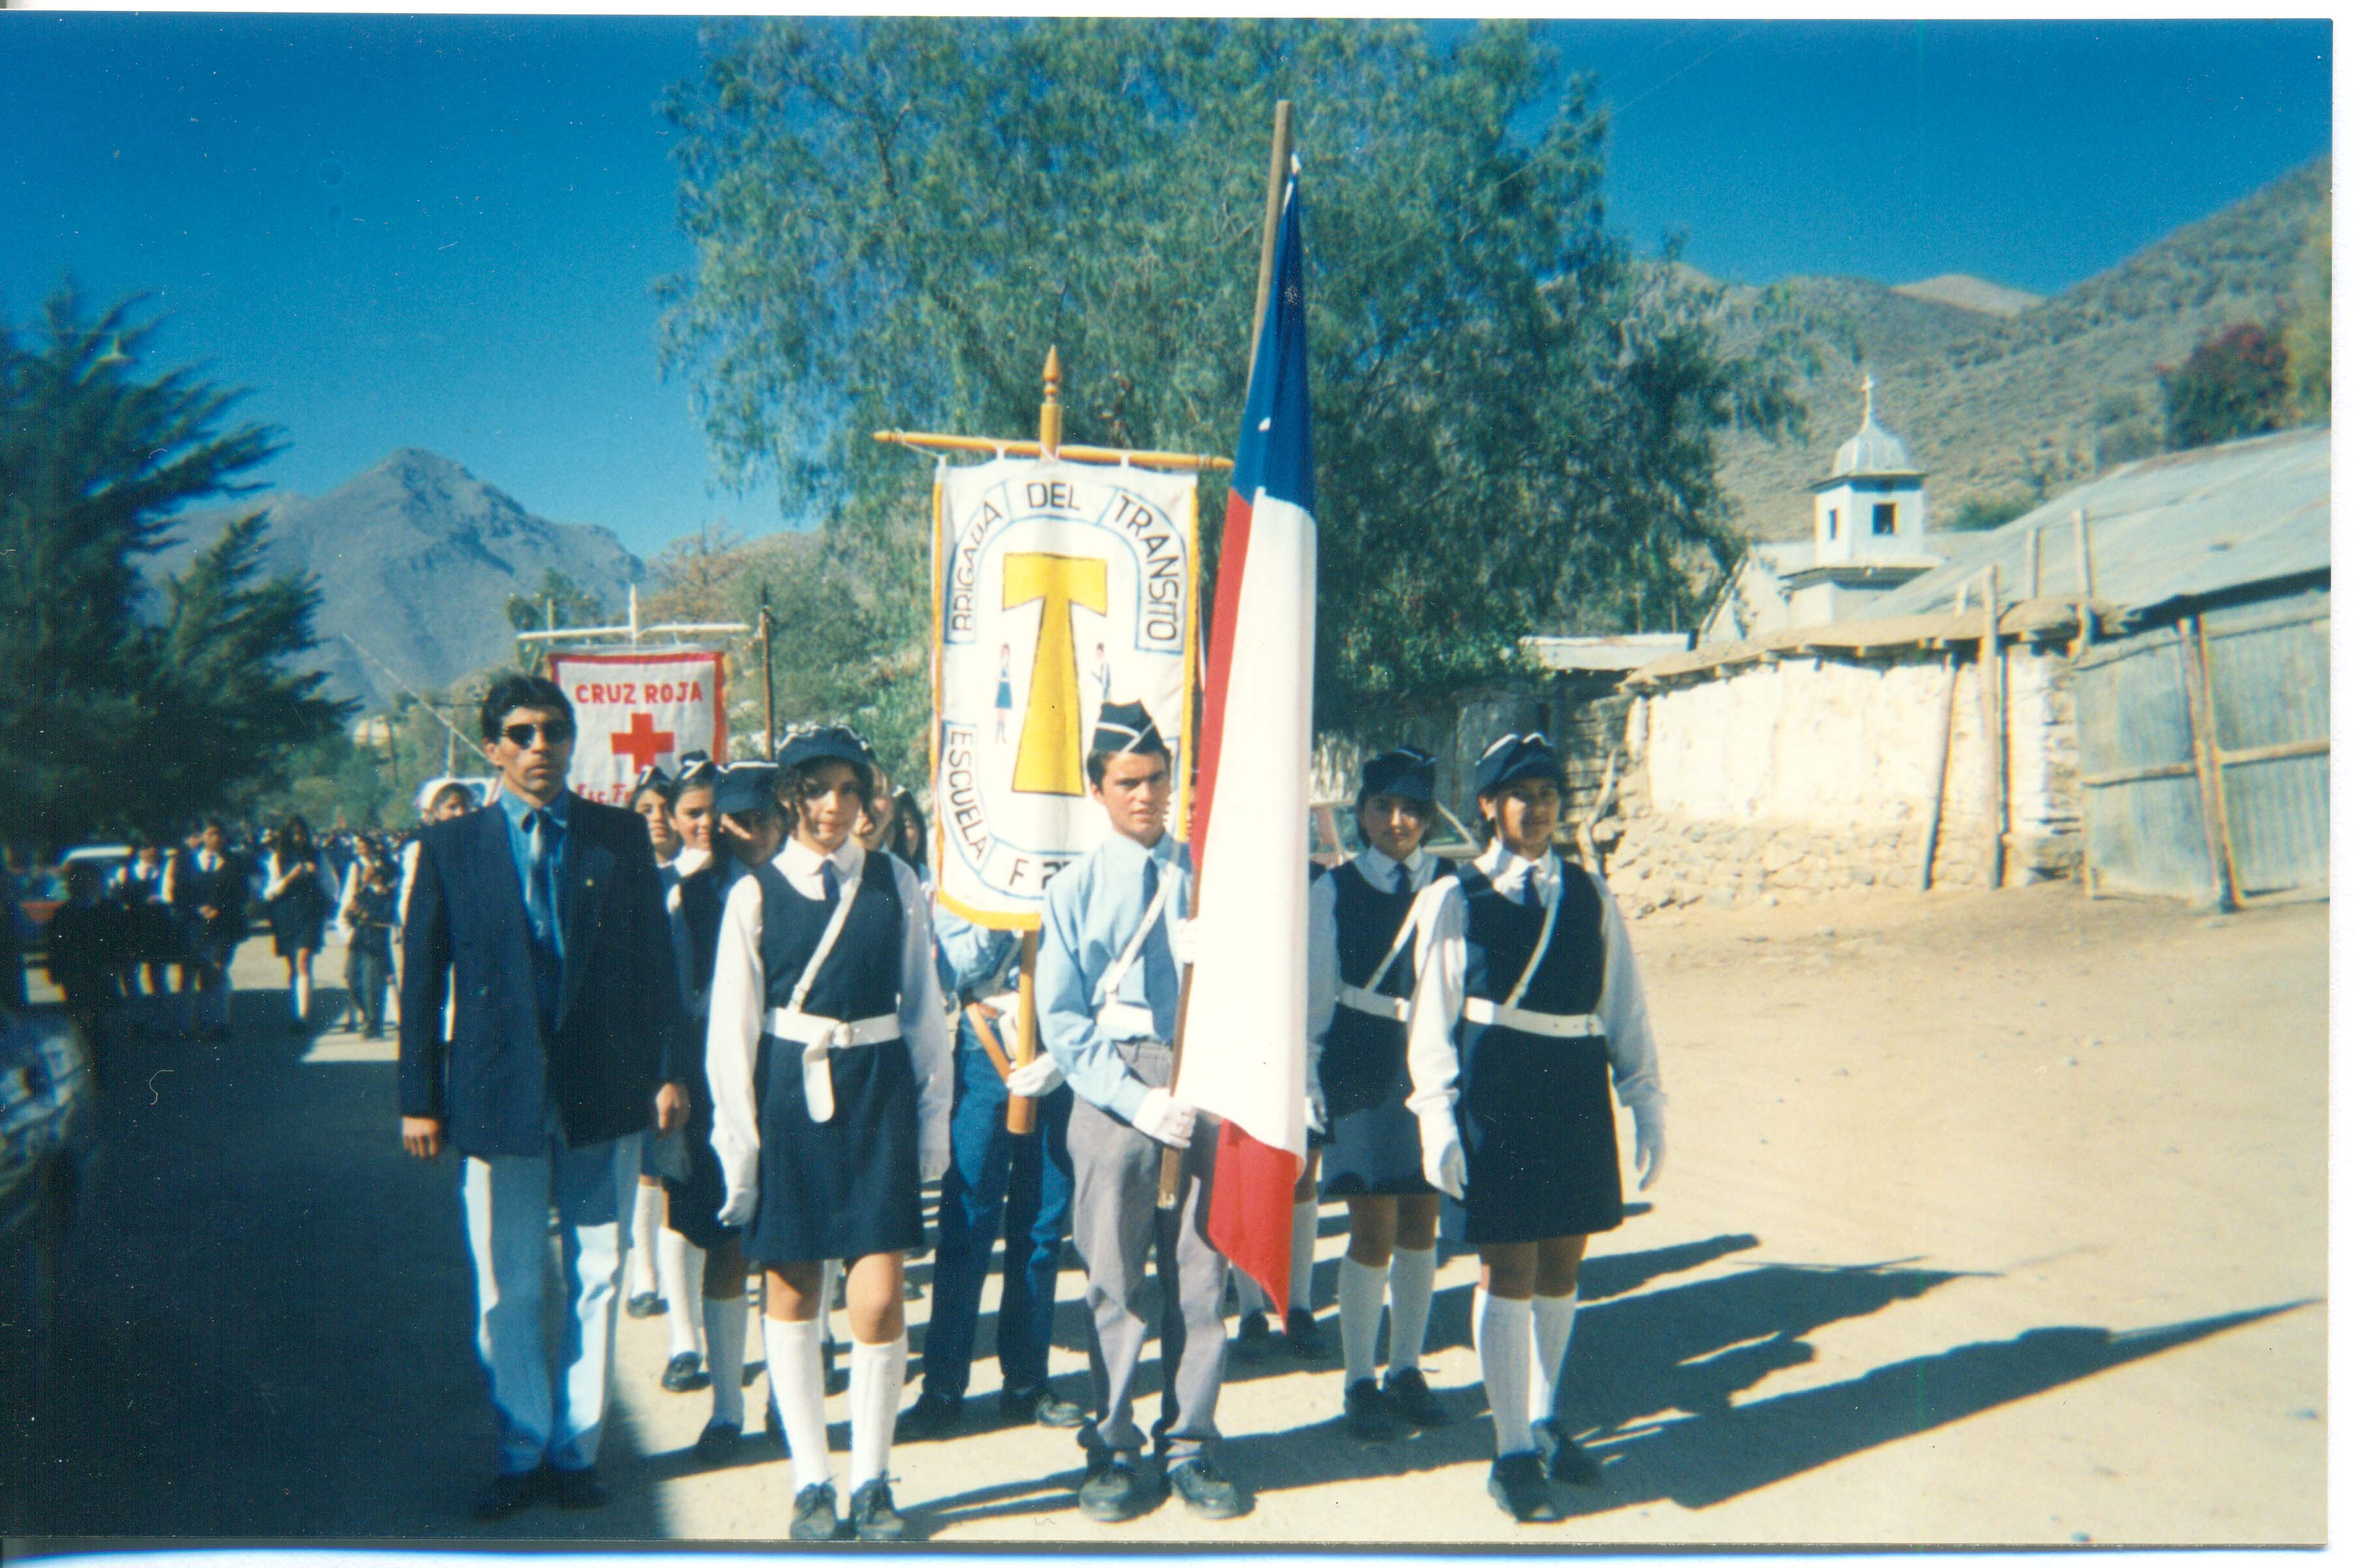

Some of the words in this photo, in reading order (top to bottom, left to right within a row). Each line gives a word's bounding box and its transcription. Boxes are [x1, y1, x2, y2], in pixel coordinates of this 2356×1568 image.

[951, 500, 1003, 631] BRIGADA
[1026, 481, 1081, 511] DEL
[1114, 493, 1179, 641] TRANSITO
[575, 682, 637, 705] CRUZ
[644, 680, 703, 705] ROJA
[949, 730, 987, 861] ESCUELA
[1009, 857, 1030, 886] F
